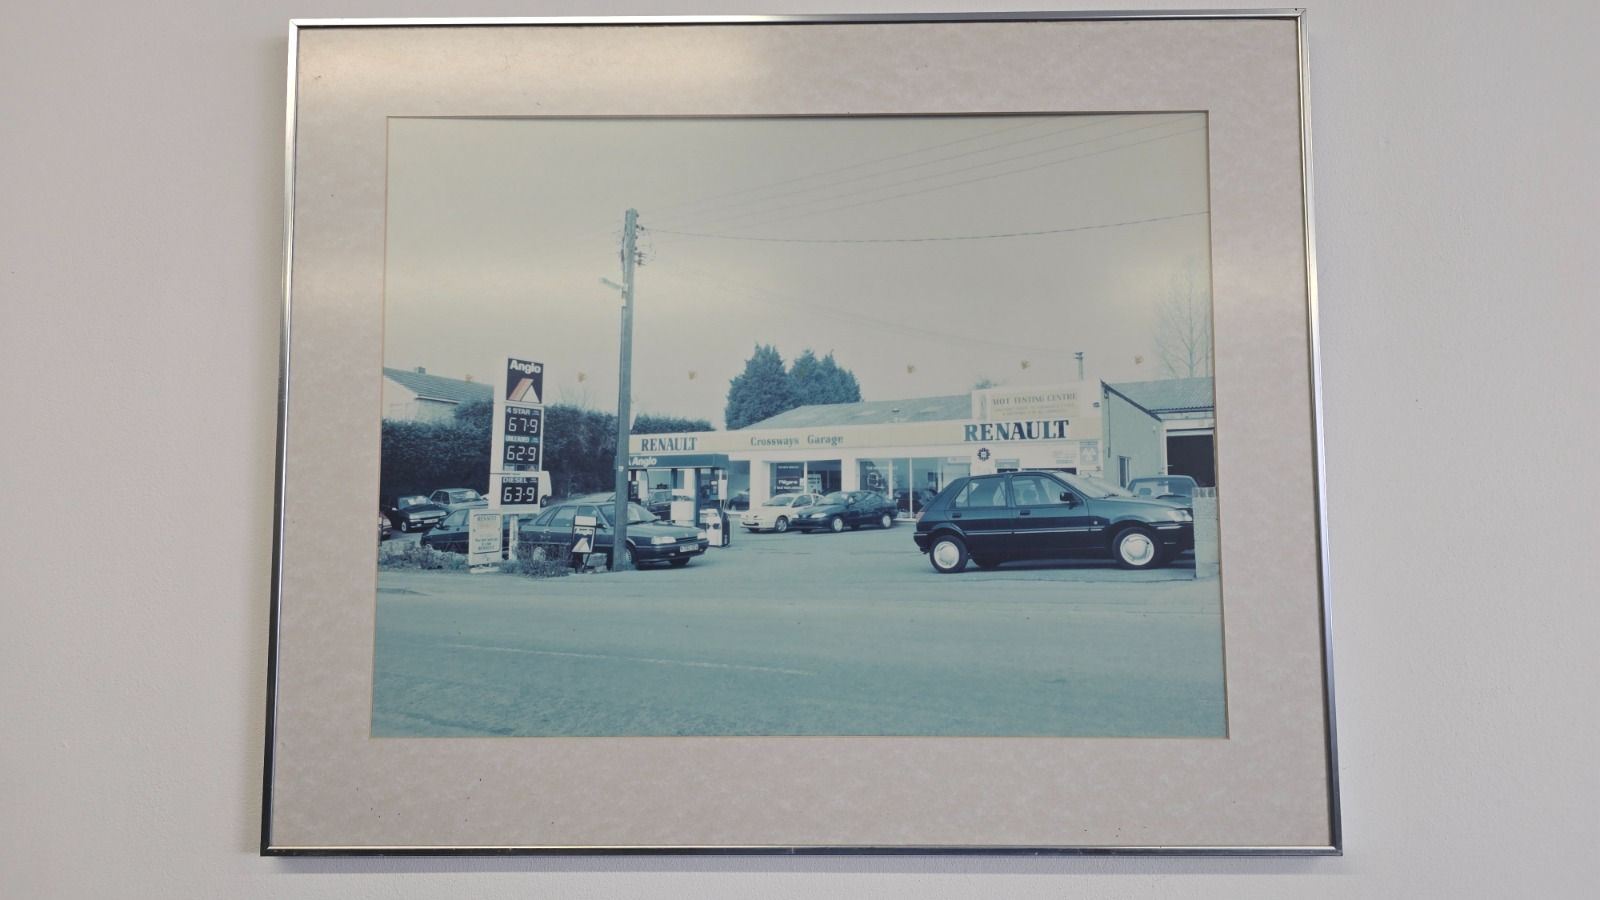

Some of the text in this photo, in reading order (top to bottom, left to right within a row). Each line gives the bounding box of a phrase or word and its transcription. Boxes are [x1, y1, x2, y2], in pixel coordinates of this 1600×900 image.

[510, 360, 541, 374] Anglo
[513, 408, 531, 416] STAR
[964, 419, 1069, 441] RENAULT
[641, 437, 697, 452] RENAULT
[750, 434, 844, 447] Crossways Garage
[632, 456, 657, 468] Anglo
[503, 476, 528, 484] DIESEL
